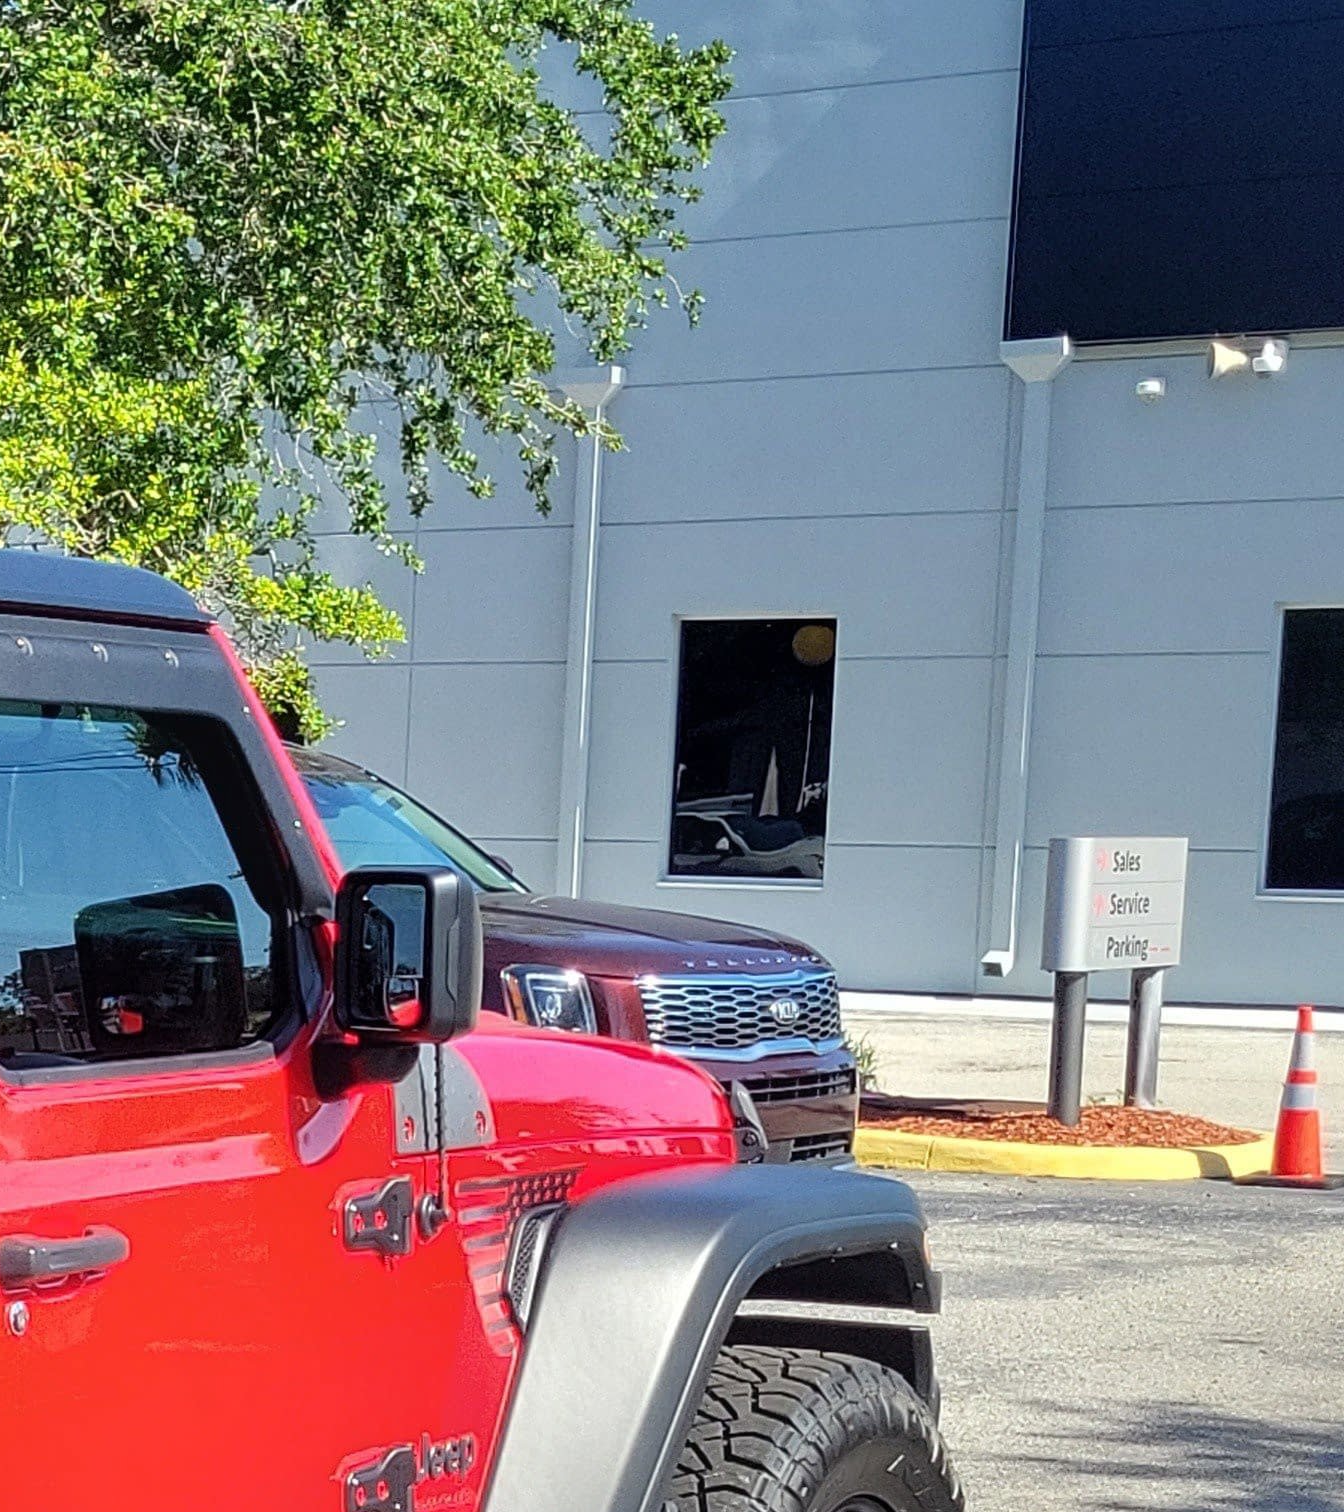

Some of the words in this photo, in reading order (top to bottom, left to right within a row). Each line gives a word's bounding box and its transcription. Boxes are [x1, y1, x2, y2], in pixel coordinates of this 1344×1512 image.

[1112, 850, 1141, 872] Sales
[1109, 892, 1150, 915] Service
[1106, 935, 1149, 961] Parking
[682, 956, 820, 969] TELLUR
[417, 1432, 475, 1482] Jeep
